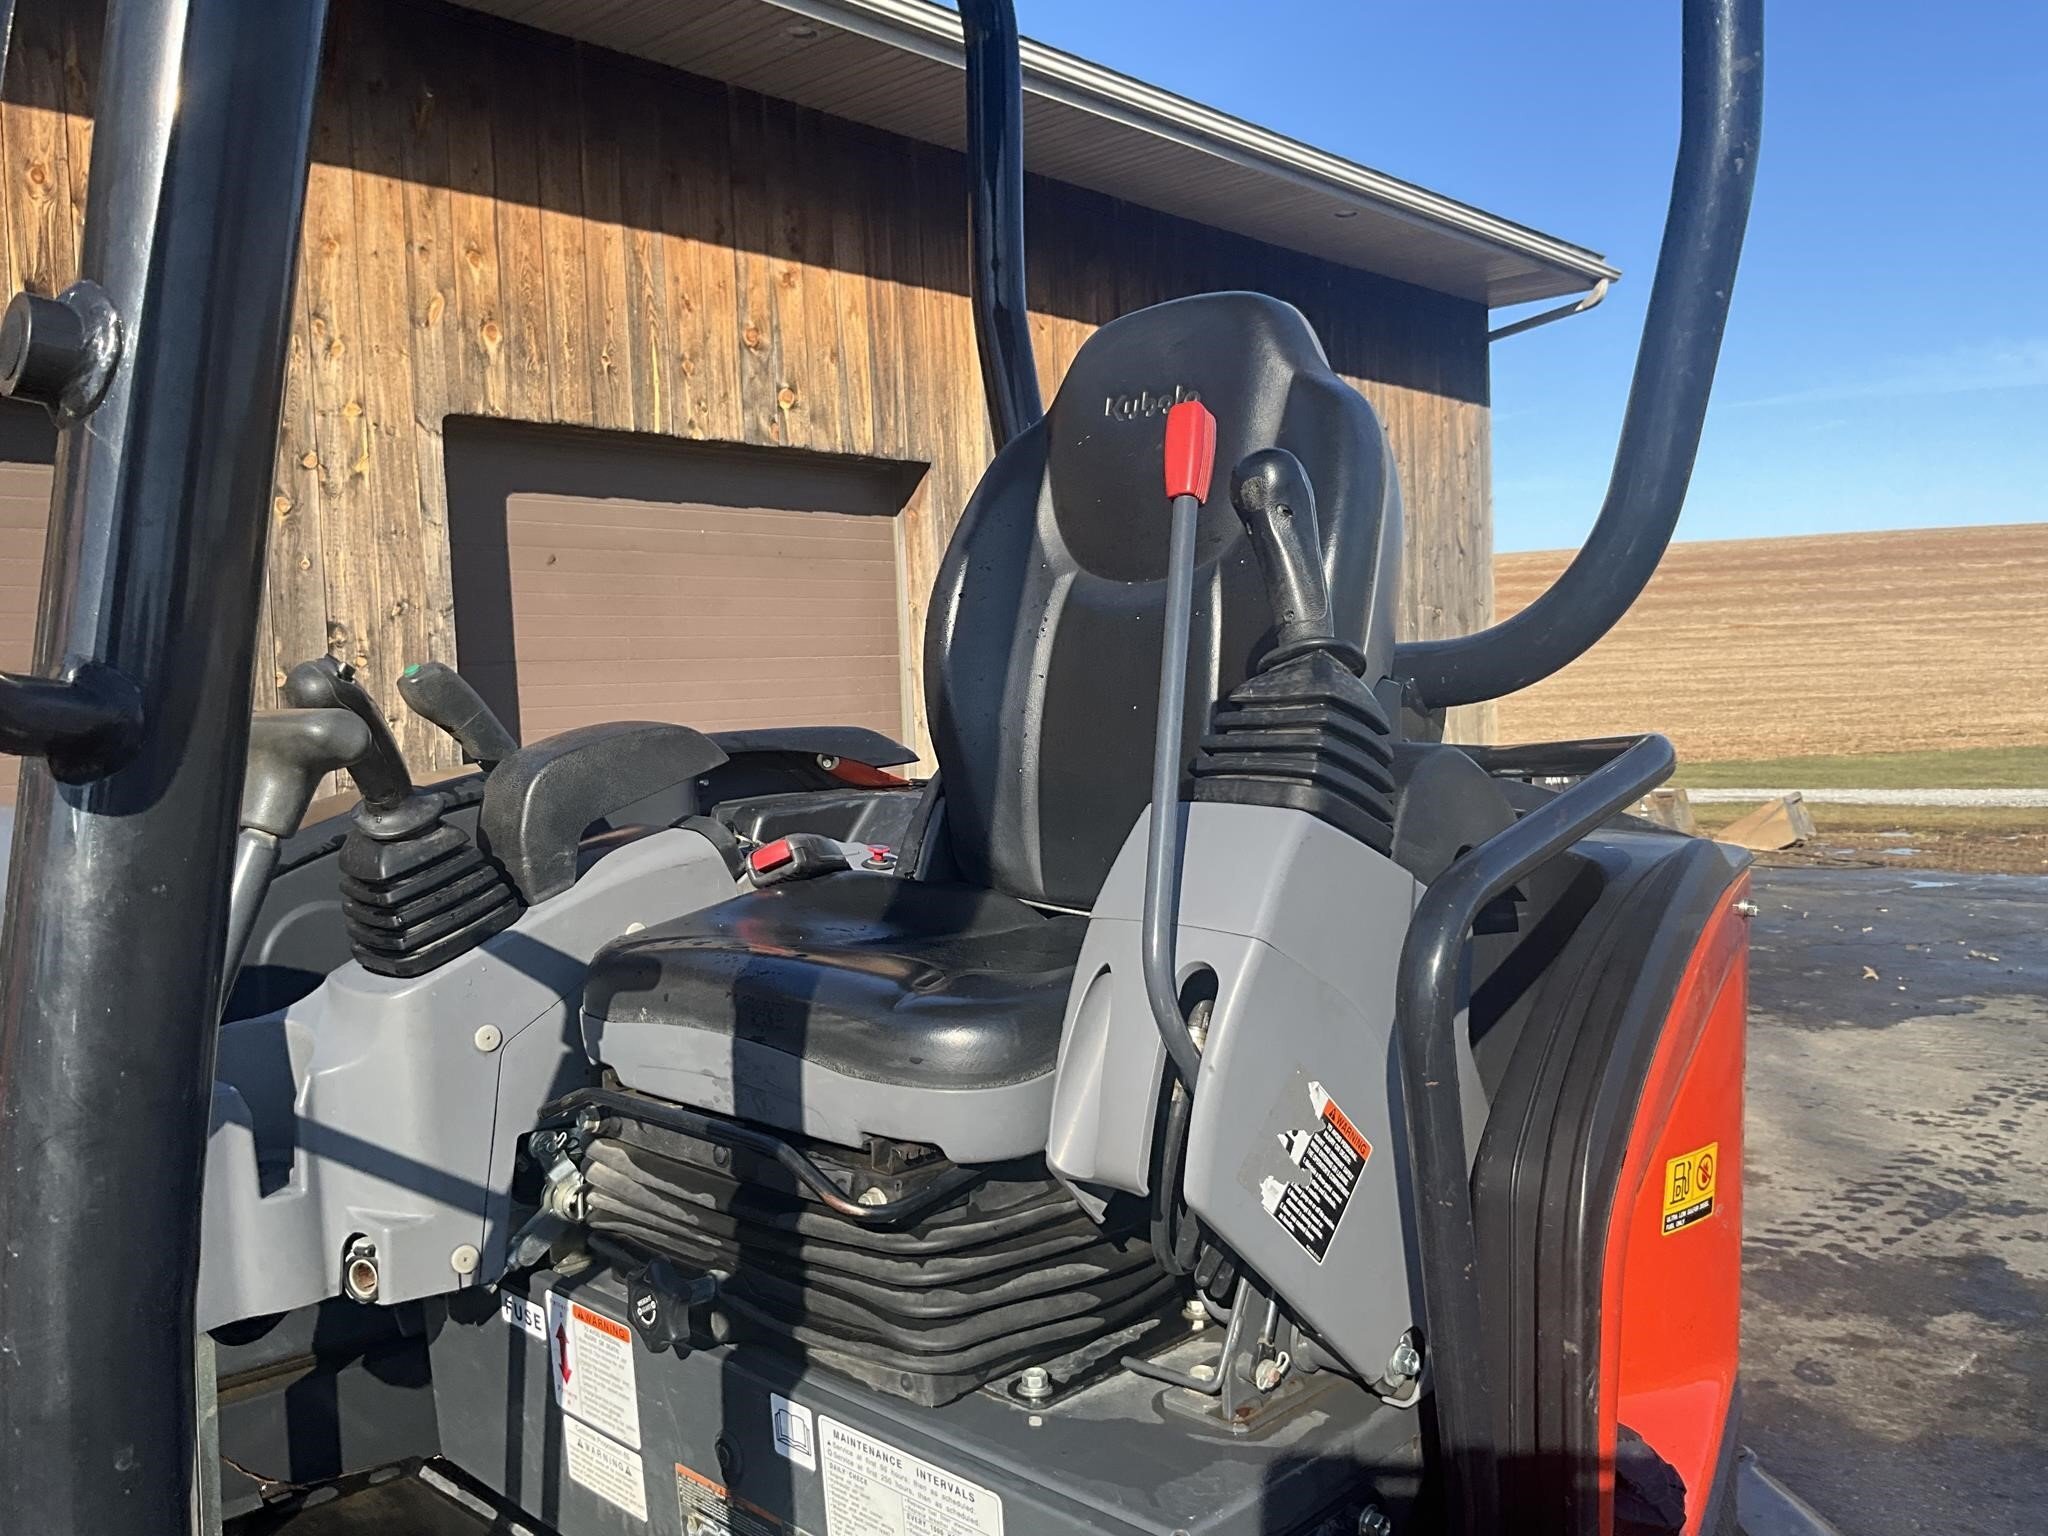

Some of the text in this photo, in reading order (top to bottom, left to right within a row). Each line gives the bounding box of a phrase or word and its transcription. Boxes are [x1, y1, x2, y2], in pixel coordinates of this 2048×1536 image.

[1337, 1115, 1366, 1155] WARNING
[504, 1295, 542, 1332] FUSE
[585, 1315, 625, 1338] WARNING
[584, 1442, 624, 1472] WARNING
[832, 1428, 903, 1469] MAINTENANCE
[916, 1467, 975, 1503] INTERVALS
[906, 1512, 926, 1528] EVERY
